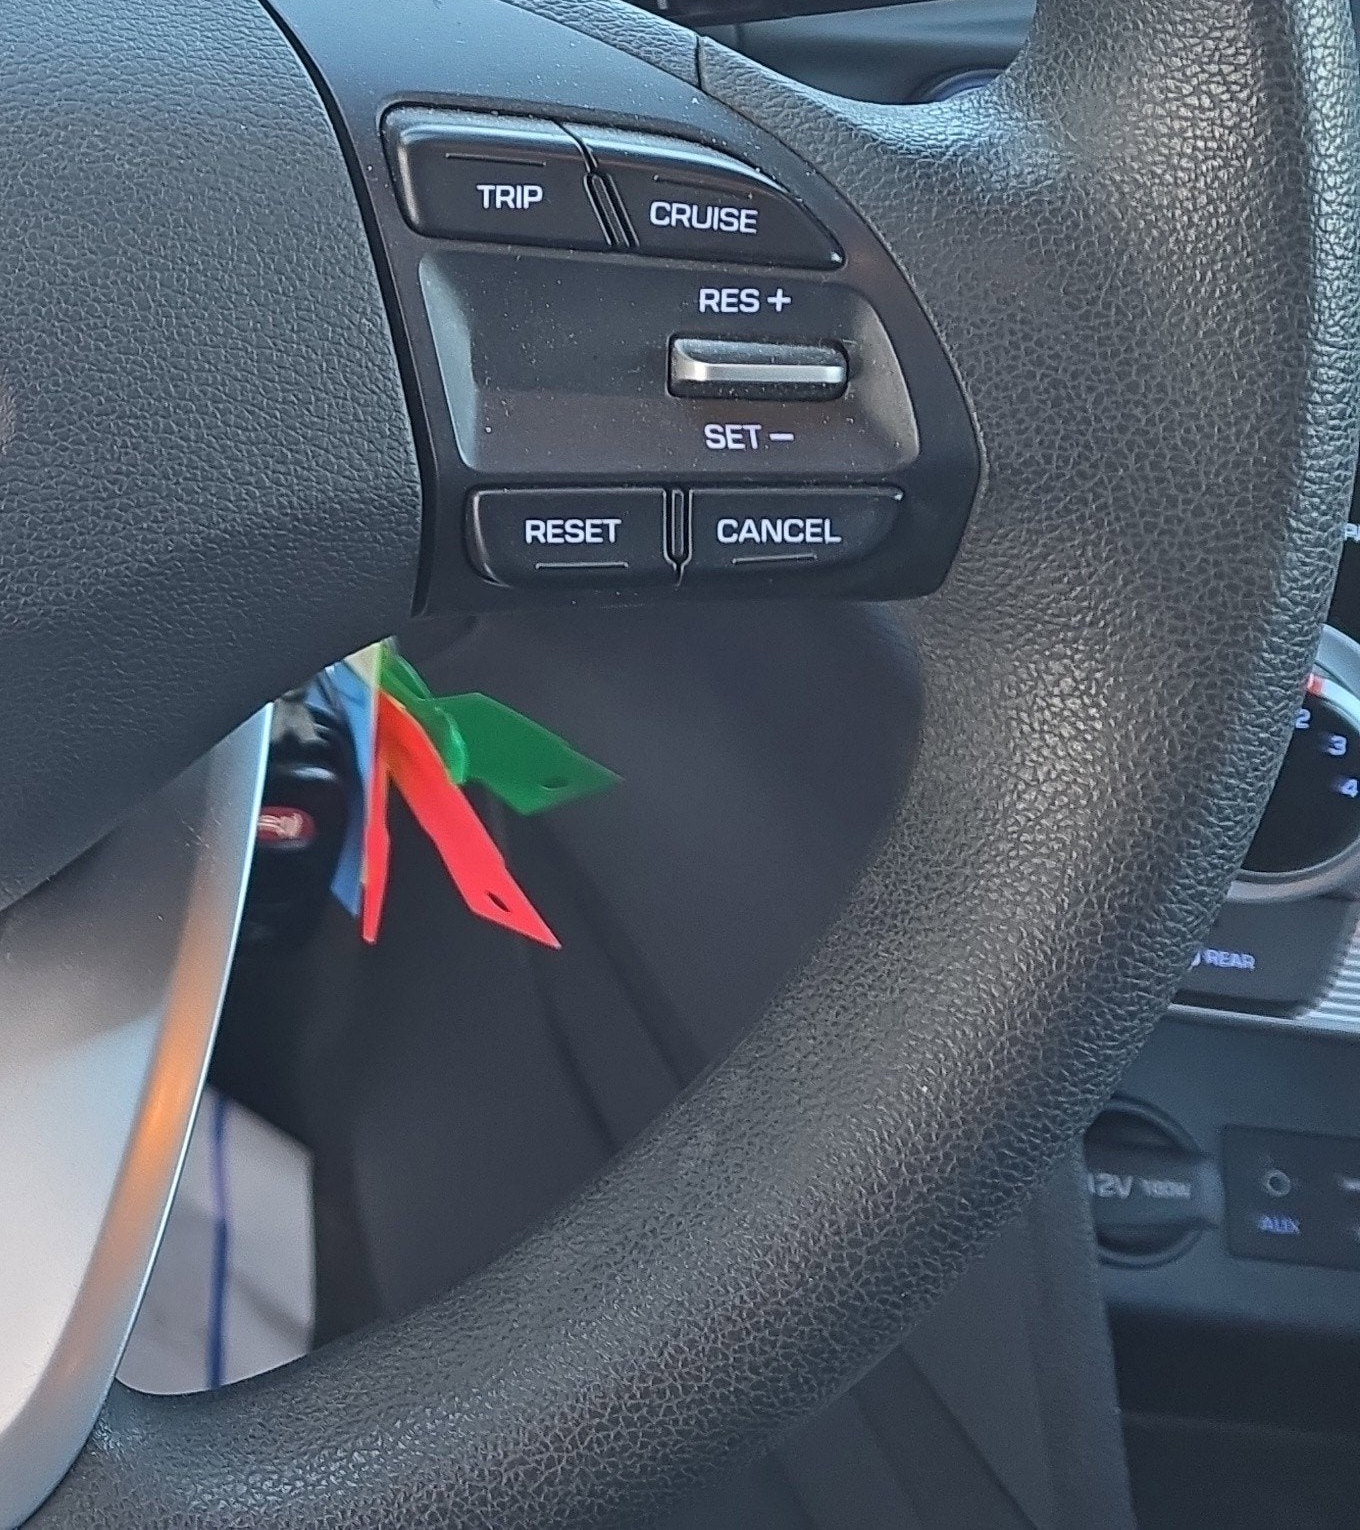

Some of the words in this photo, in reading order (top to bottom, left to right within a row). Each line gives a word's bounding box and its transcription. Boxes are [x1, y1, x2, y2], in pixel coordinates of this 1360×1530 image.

[477, 184, 544, 210] TRIP
[648, 200, 759, 235] CRUISE
[524, 518, 622, 544] RESET
[716, 518, 842, 544] CANCEL
[1328, 735, 1347, 756] 3
[1341, 778, 1359, 799] 4
[1203, 949, 1255, 969] REAR
[1259, 1214, 1300, 1235] AUX
